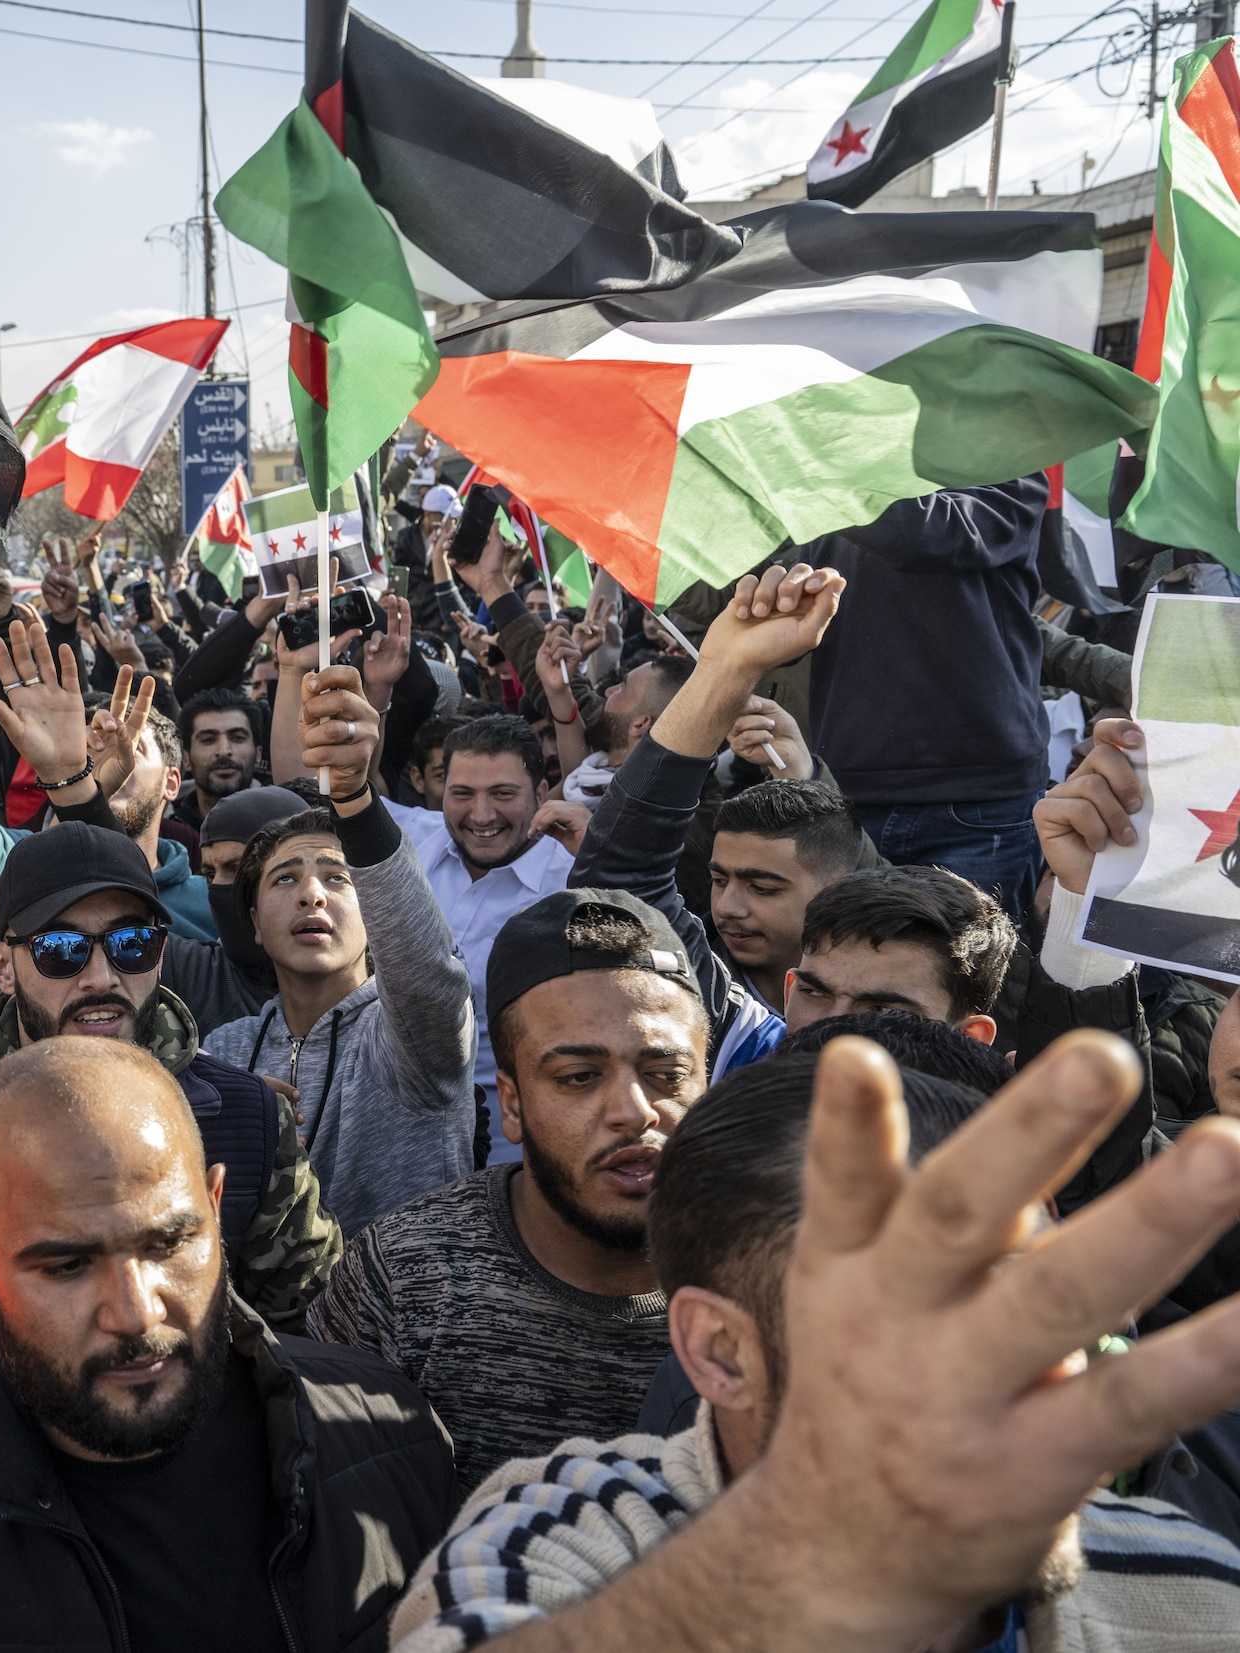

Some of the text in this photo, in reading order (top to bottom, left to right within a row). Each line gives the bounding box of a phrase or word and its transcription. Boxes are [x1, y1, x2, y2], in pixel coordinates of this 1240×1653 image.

[194, 386, 234, 406] القدس
[197, 417, 235, 436] نابلس
[185, 448, 235, 469] بيت لحم
